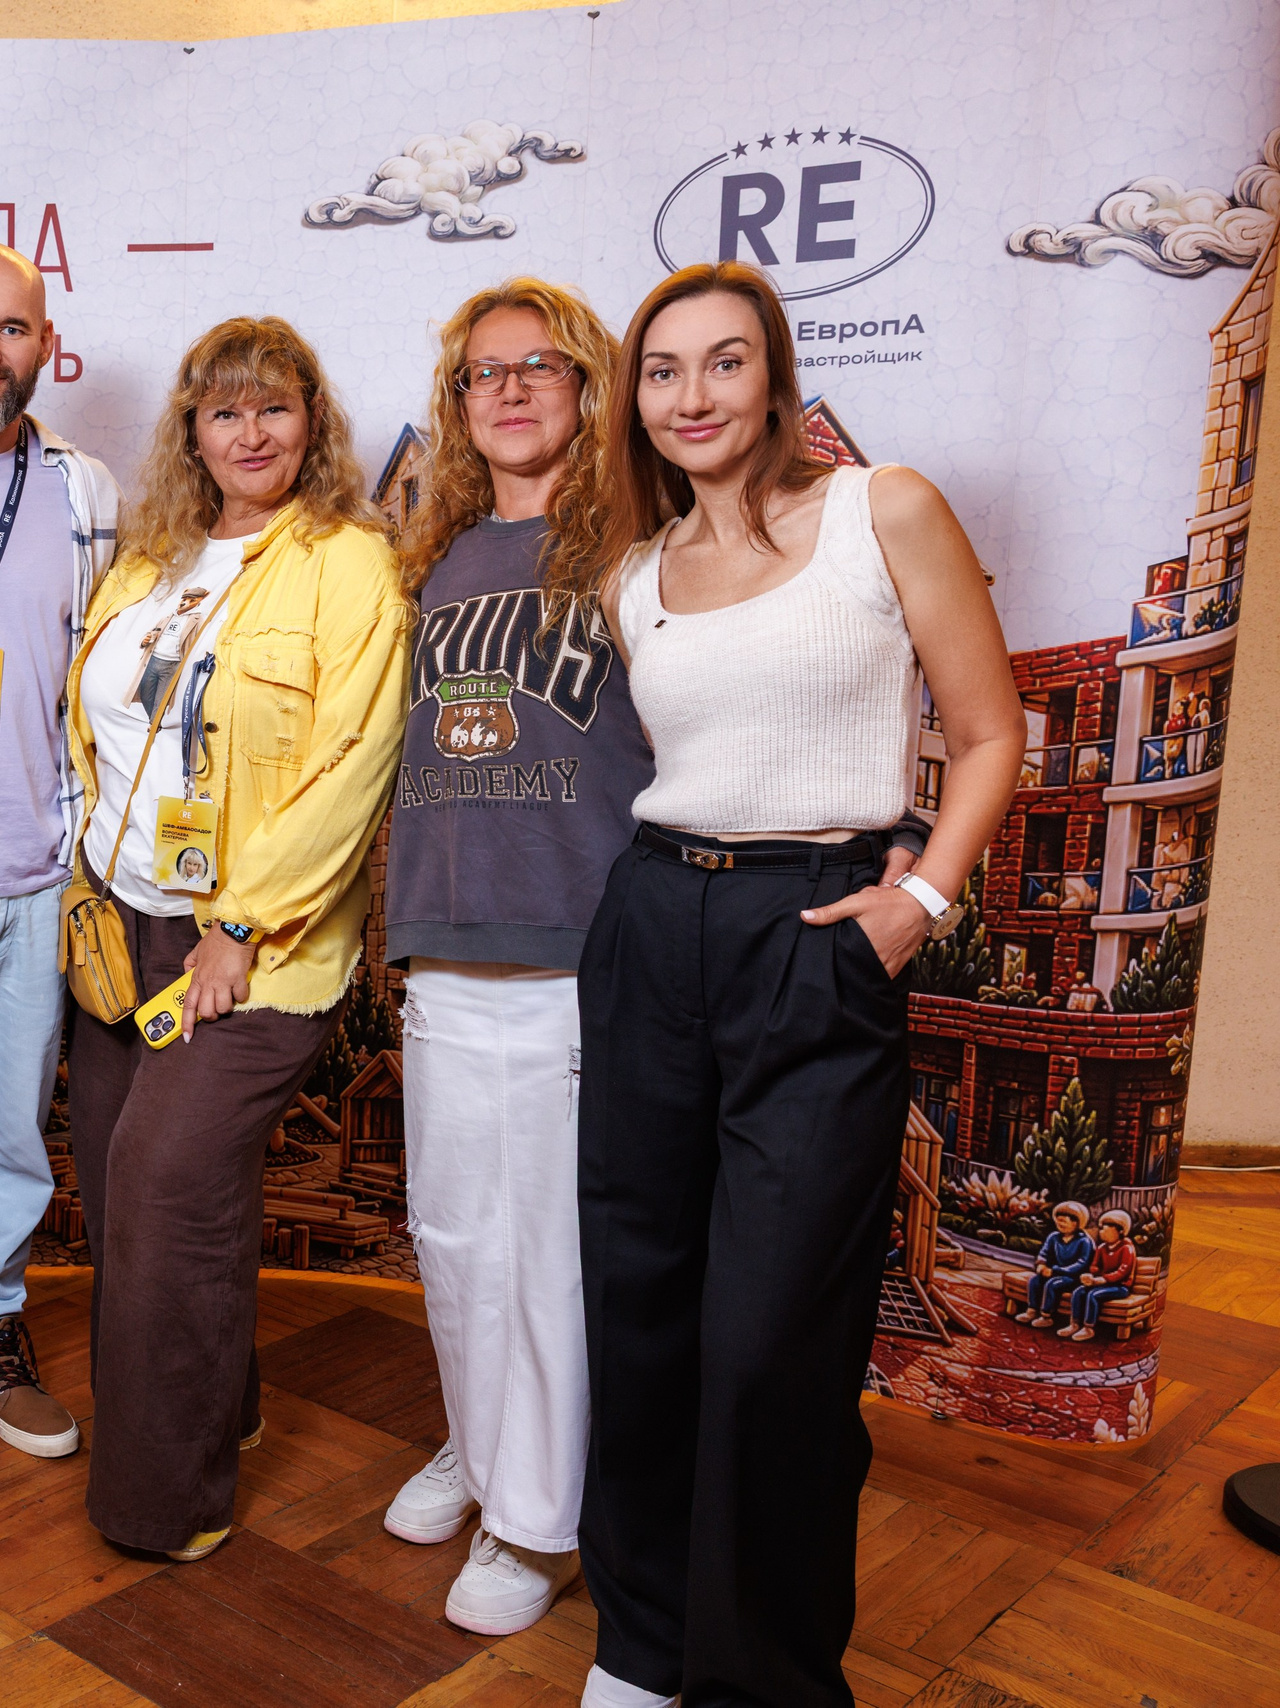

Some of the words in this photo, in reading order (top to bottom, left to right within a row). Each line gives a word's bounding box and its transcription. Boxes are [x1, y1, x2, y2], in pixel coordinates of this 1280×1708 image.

[718, 160, 862, 266] RE
[4, 513, 12, 523] RE
[449, 681, 498, 697] ROUTE
[450, 717, 499, 749] 66
